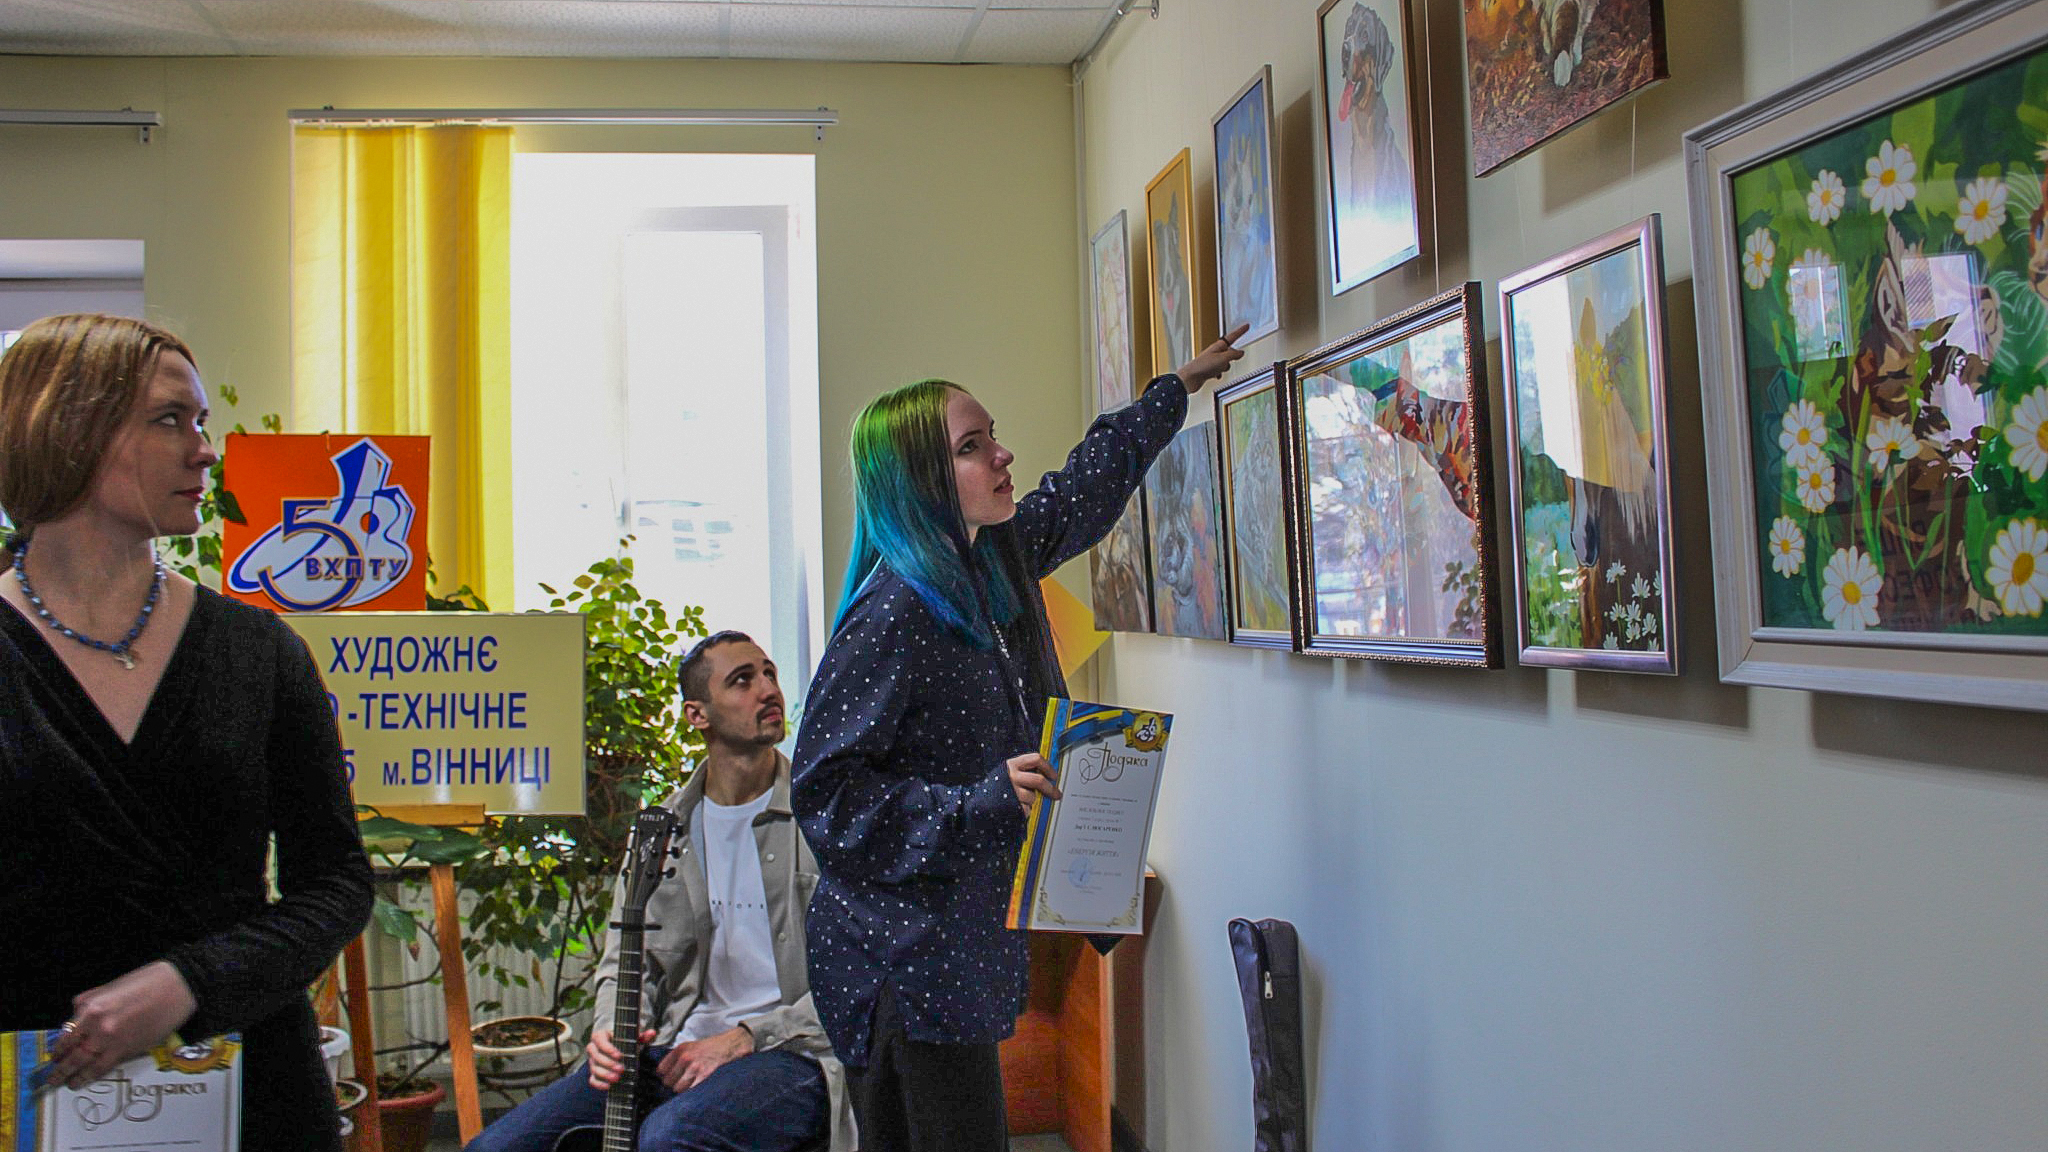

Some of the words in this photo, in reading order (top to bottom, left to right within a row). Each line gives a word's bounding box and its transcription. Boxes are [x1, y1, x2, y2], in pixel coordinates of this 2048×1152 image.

[305, 556, 406, 580] ВХПТУ
[329, 636, 498, 680] ХУДОЖНЄ
[1079, 741, 1149, 785] Подяка
[74, 1069, 208, 1131] Подяка
